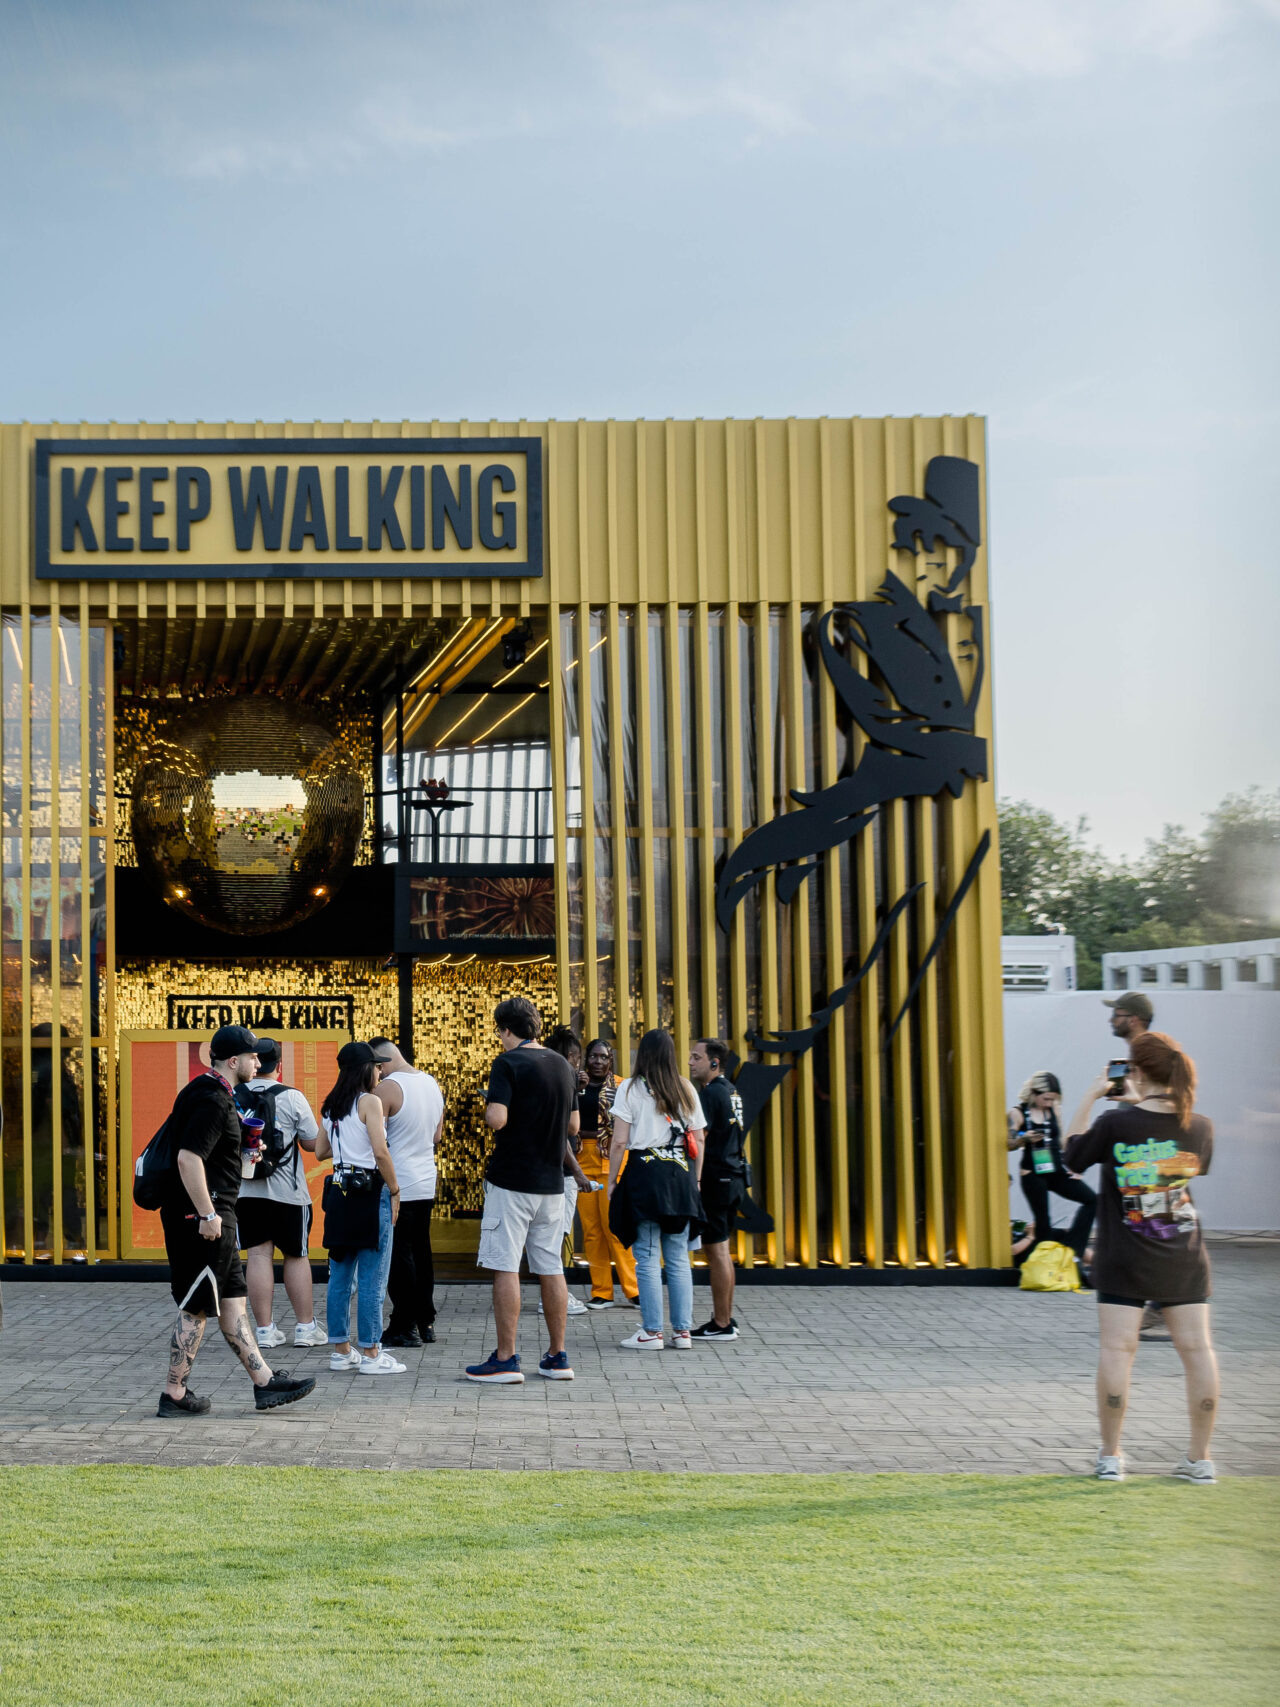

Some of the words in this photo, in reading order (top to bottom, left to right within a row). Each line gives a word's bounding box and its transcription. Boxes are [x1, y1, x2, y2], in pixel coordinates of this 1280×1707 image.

[61, 466, 212, 552] KEEP
[227, 464, 518, 551] WALKING
[177, 1004, 233, 1029] KEEP
